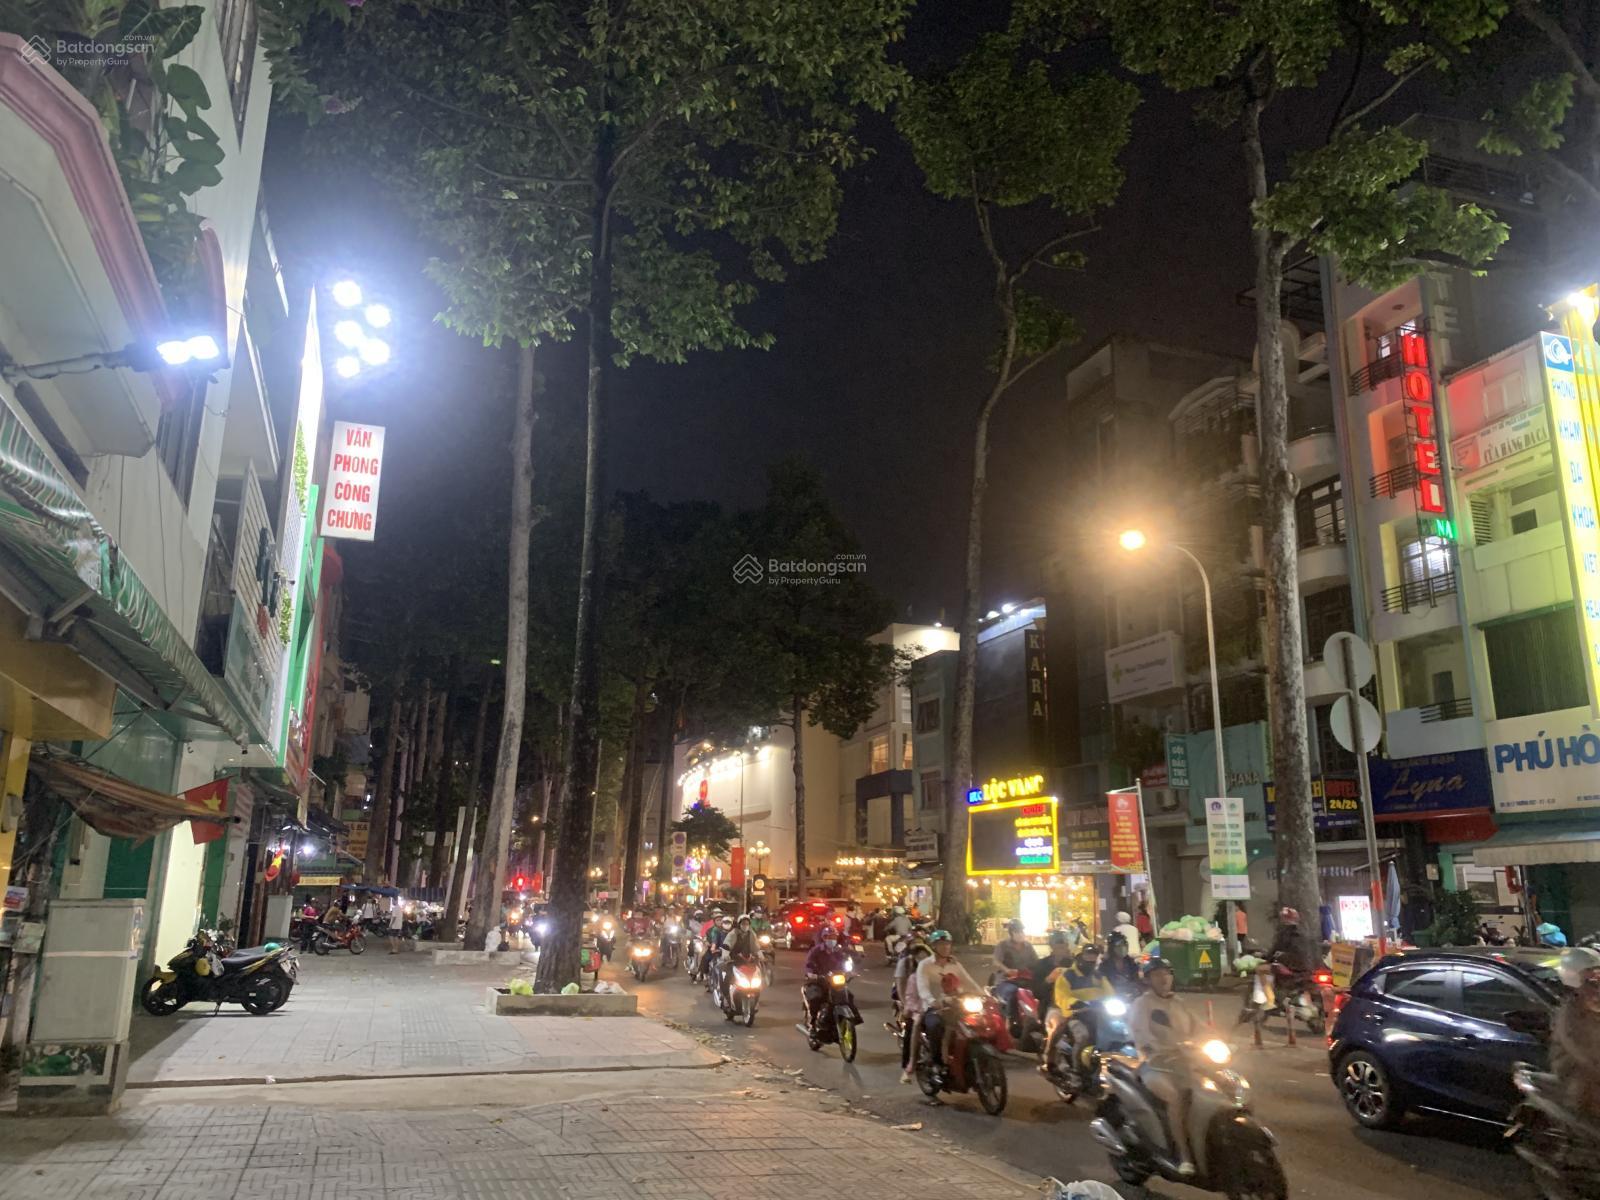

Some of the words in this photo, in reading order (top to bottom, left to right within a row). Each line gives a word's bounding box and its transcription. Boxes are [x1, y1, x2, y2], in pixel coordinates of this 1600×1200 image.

[1402, 334, 1445, 513] HOTEL
[334, 480, 371, 503] CÔNG
[1030, 634, 1043, 716] KARA
[1494, 730, 1554, 773] PHÚ
[1329, 799, 1358, 810] 24/24
